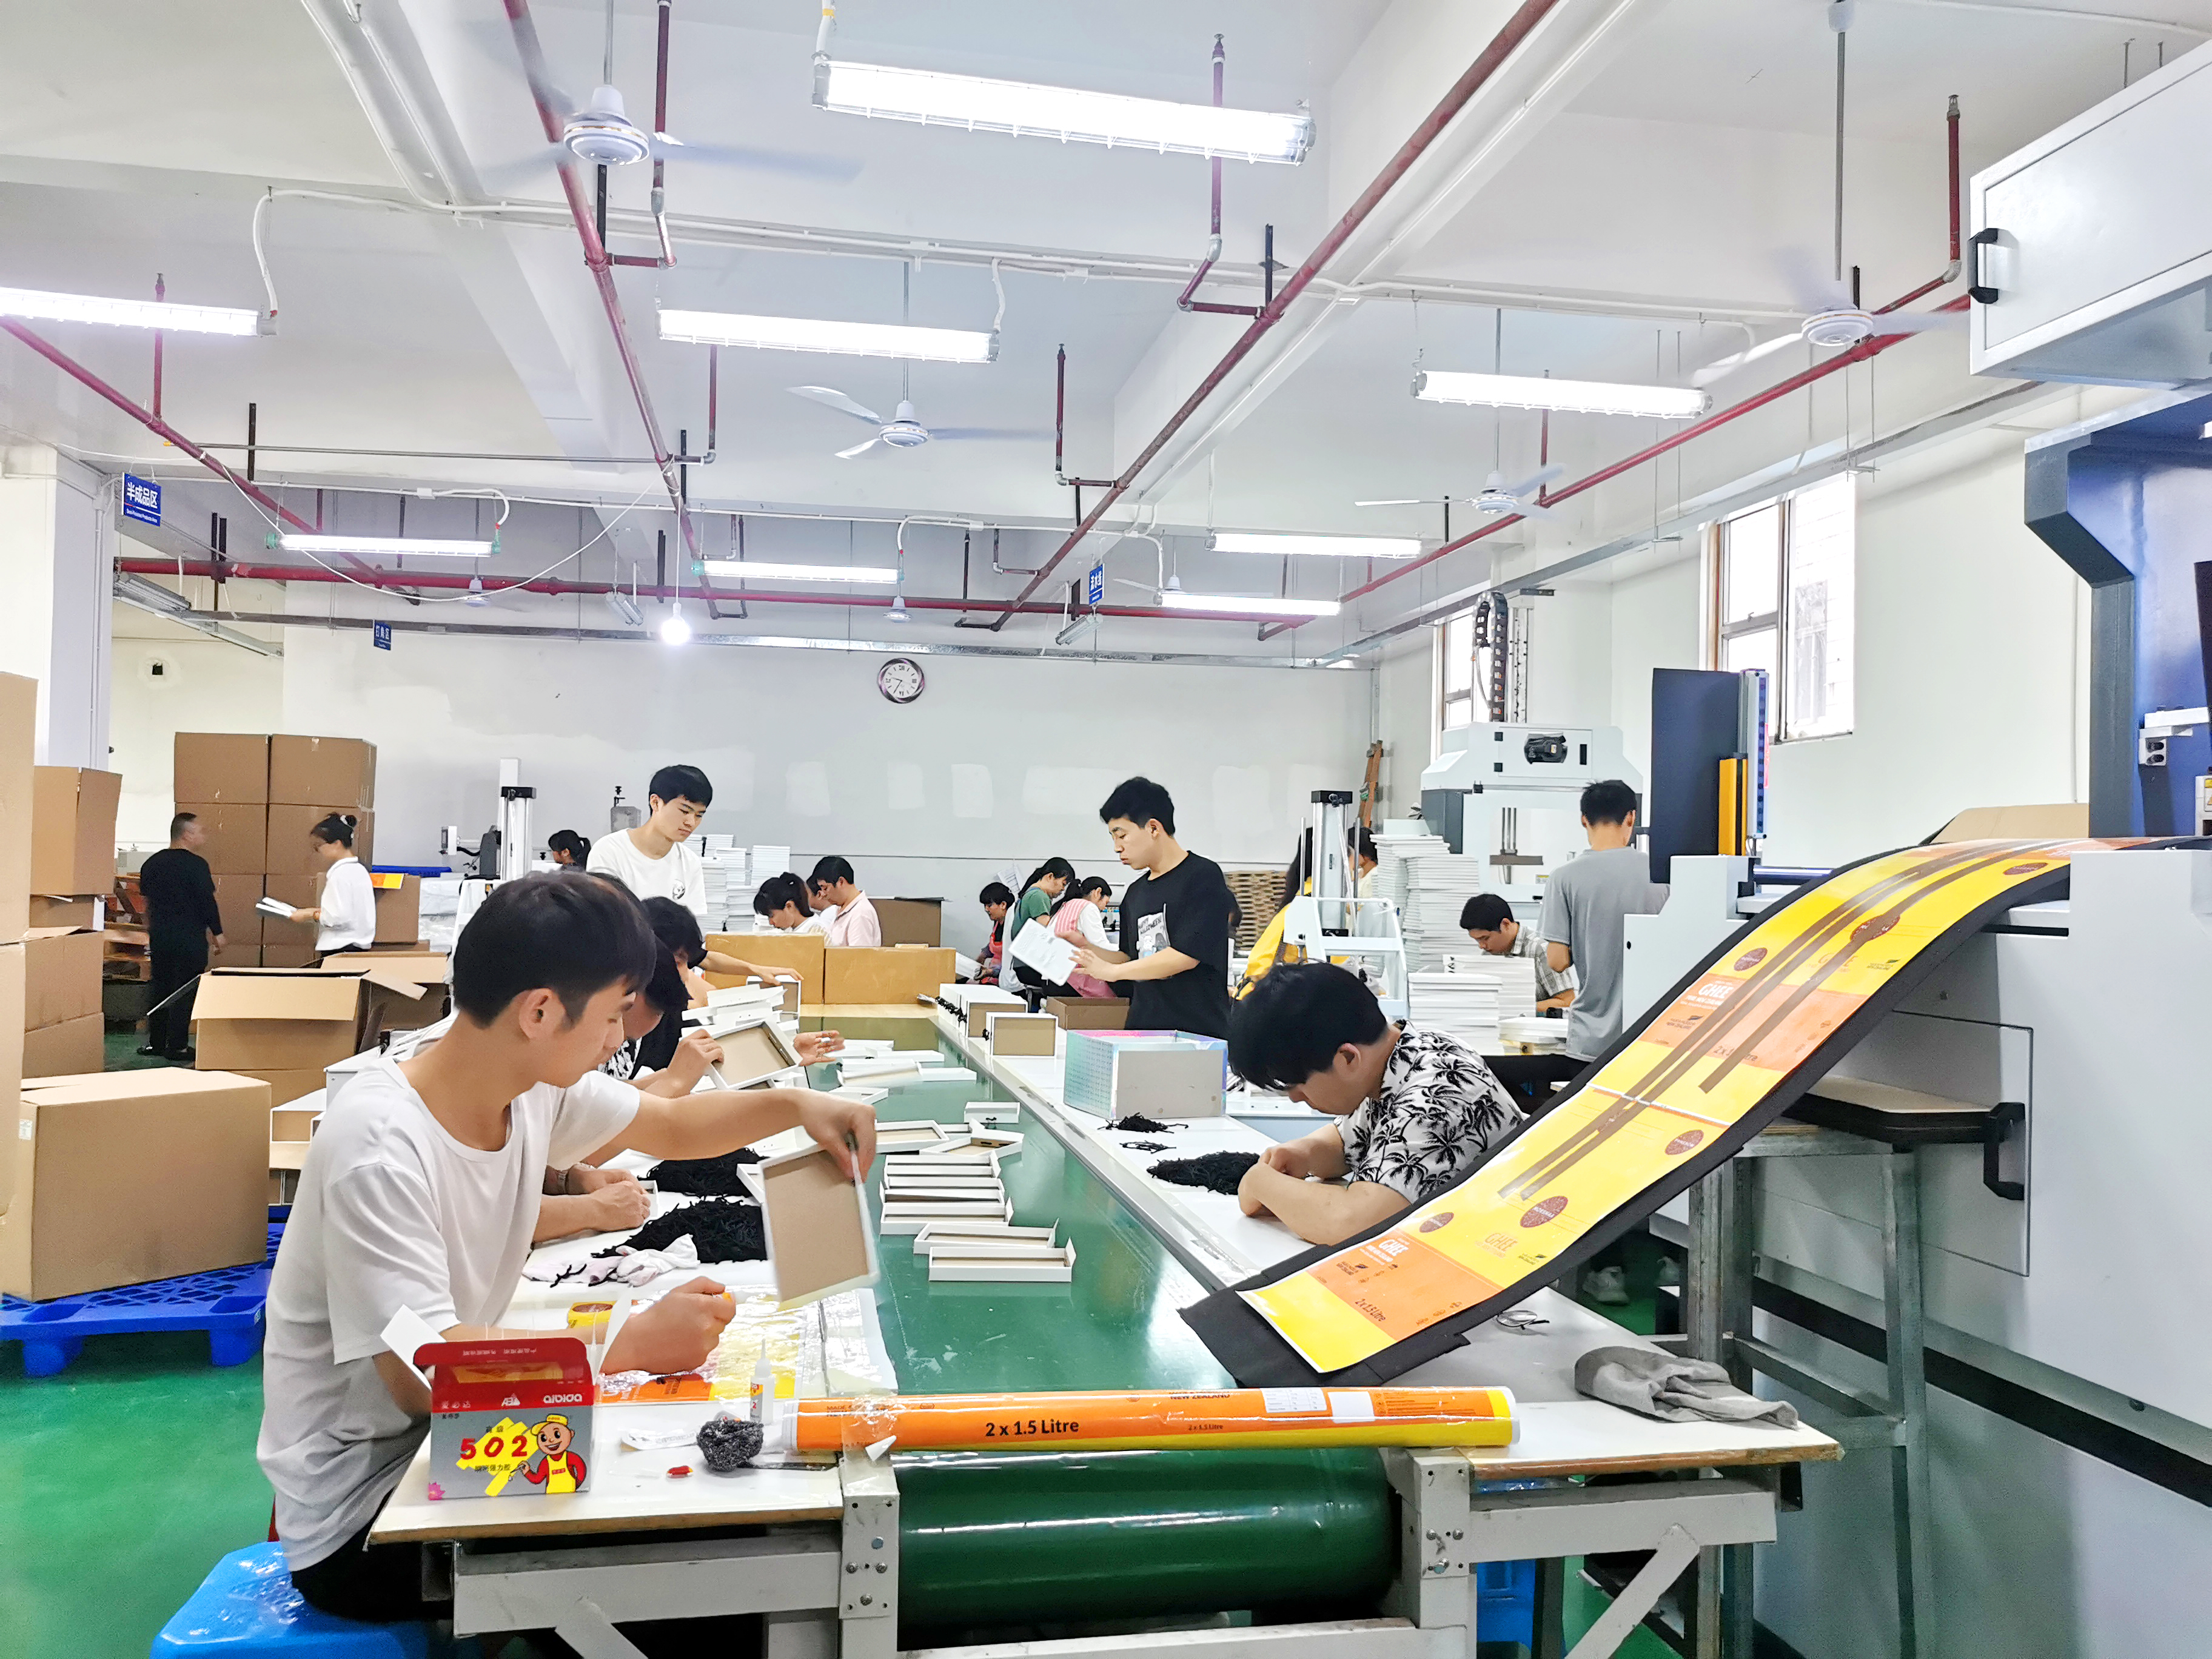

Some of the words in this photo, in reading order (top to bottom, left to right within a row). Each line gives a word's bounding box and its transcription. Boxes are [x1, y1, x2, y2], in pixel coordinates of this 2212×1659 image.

[127, 482, 158, 509] 半成品区
[1818, 953, 1858, 967] GE
[1698, 984, 1734, 998] GHEE
[1378, 1239, 1409, 1256] GHEE
[1485, 1233, 1518, 1252] GHEE
[985, 1423, 995, 1436] 2
[999, 1425, 1009, 1436] x
[1014, 1420, 1036, 1435] 1.5
[1041, 1418, 1079, 1434] Litre
[460, 1435, 528, 1460] 502
